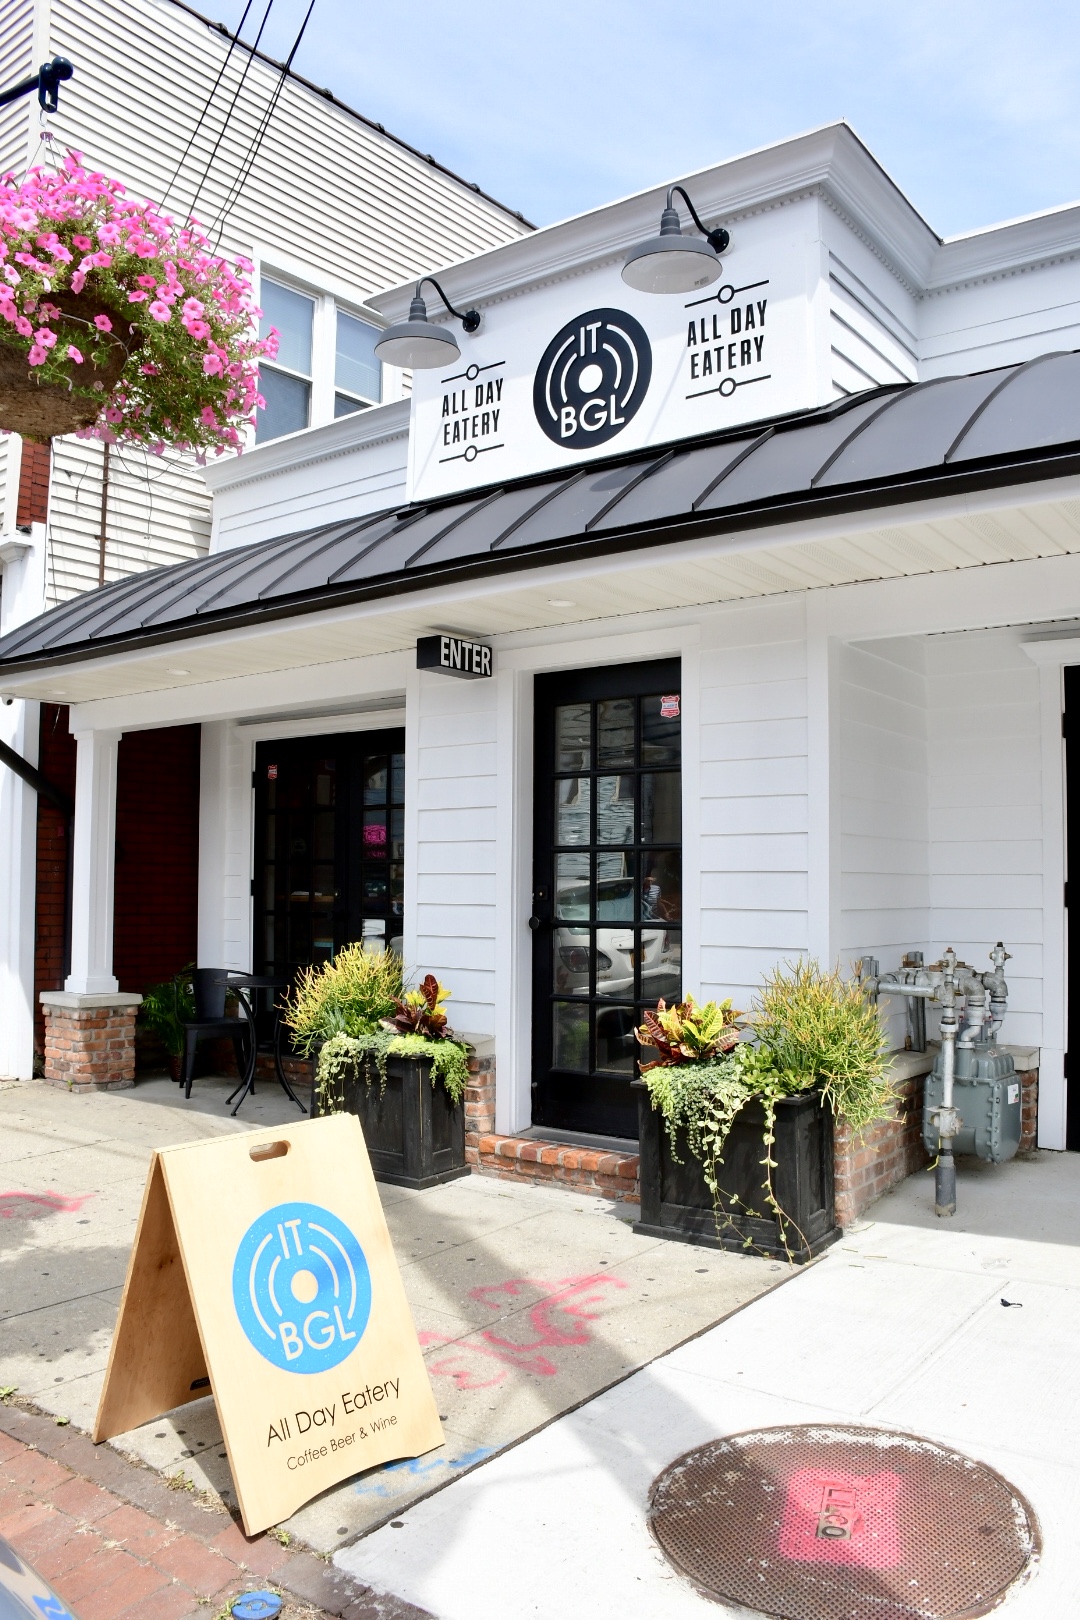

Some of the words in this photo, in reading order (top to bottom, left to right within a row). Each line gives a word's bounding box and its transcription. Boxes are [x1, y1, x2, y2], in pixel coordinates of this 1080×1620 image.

[580, 321, 602, 357] IT
[687, 313, 722, 348] ALL
[730, 299, 768, 336] DAY
[690, 334, 765, 380] EATERY
[441, 389, 468, 418] ALL
[475, 377, 503, 408] DAY
[560, 394, 625, 438] BGL
[443, 408, 500, 446] EATERY
[440, 636, 491, 676] ENTER
[277, 1218, 303, 1260] IT
[278, 1304, 357, 1361] BGL
[267, 1417, 291, 1448] All
[295, 1403, 336, 1434] Day
[341, 1377, 400, 1415] Eatery
[286, 1448, 328, 1471] Coffee
[329, 1432, 356, 1452] Beer
[359, 1426, 368, 1440] &
[369, 1414, 398, 1434] Wine
